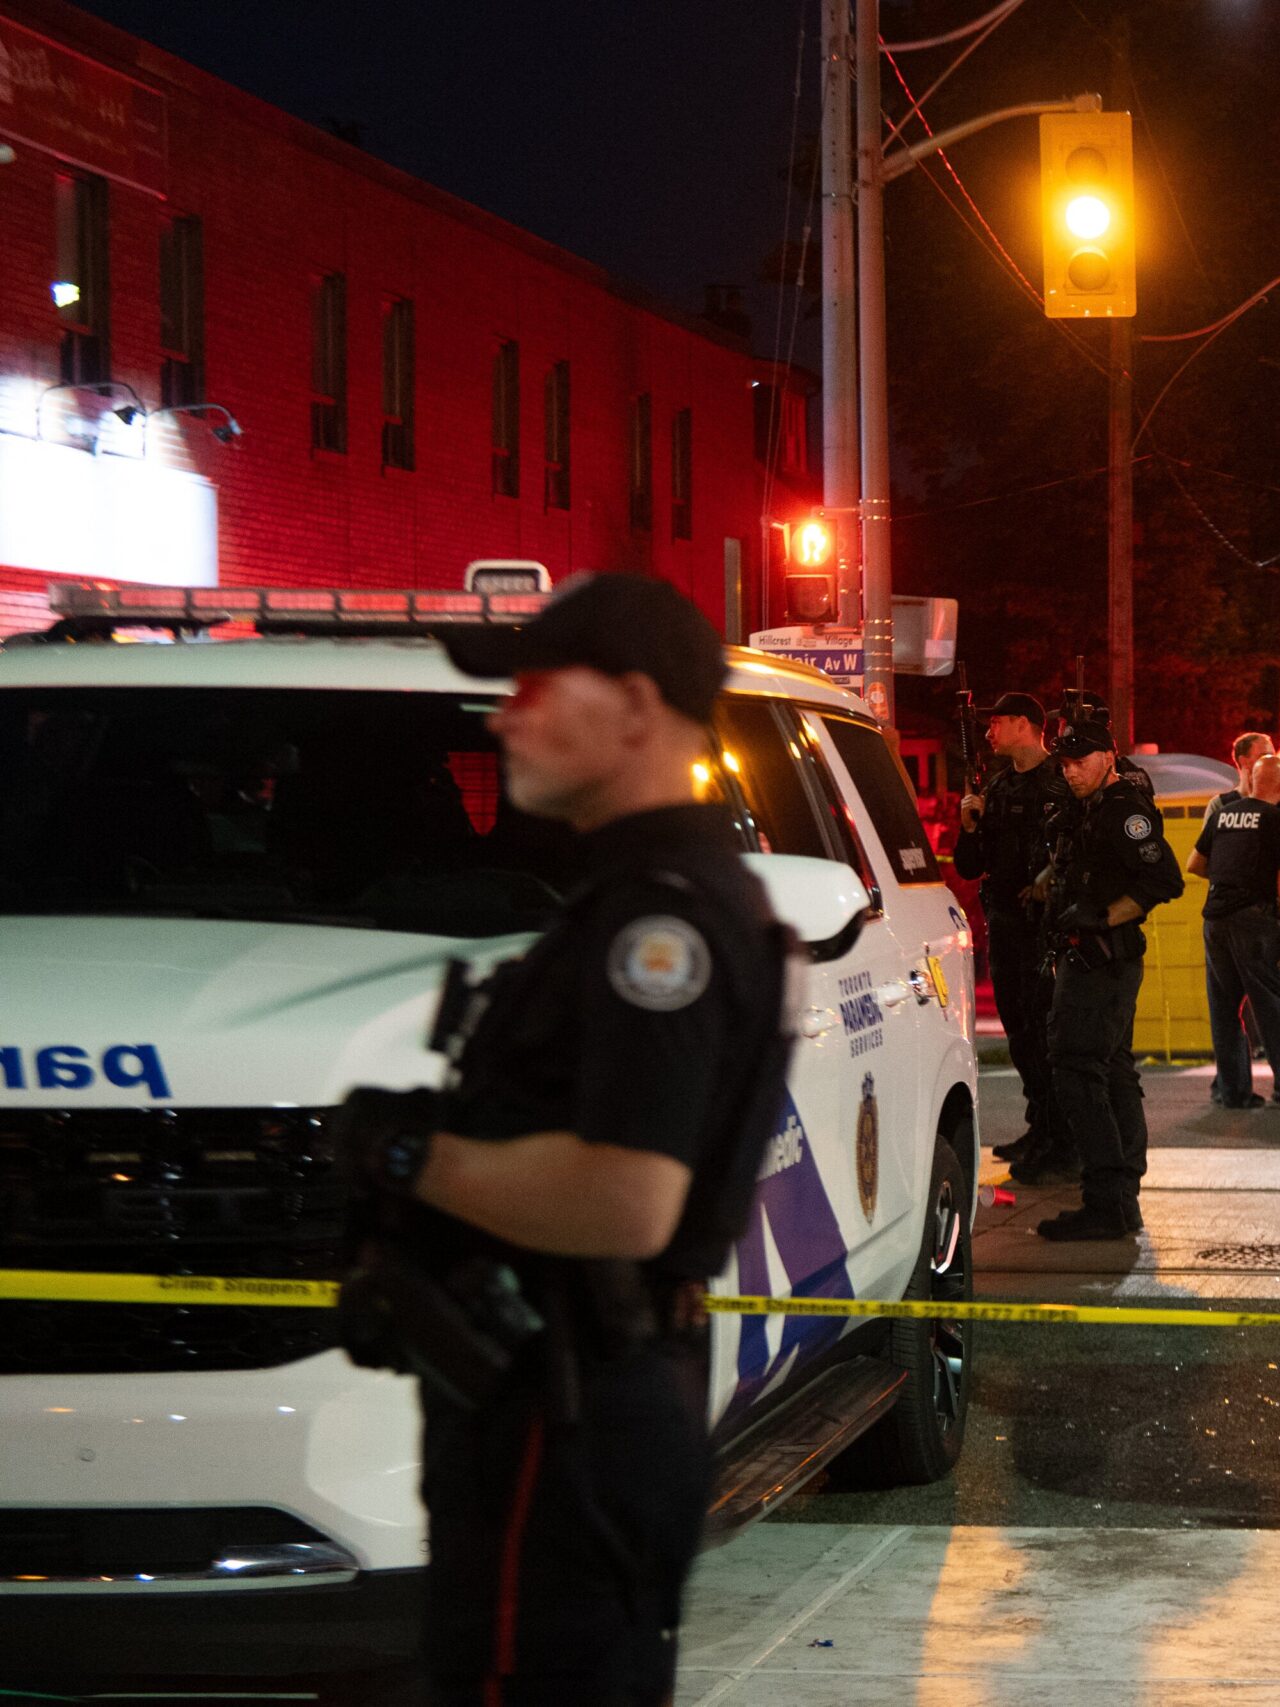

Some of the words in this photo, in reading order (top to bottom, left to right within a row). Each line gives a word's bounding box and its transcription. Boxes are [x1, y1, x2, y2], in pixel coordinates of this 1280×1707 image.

[759, 635, 791, 645] Hillcrest
[825, 635, 853, 647] Village
[824, 657, 840, 670] Av
[843, 654, 857, 670] W
[1217, 812, 1261, 828] POLICE
